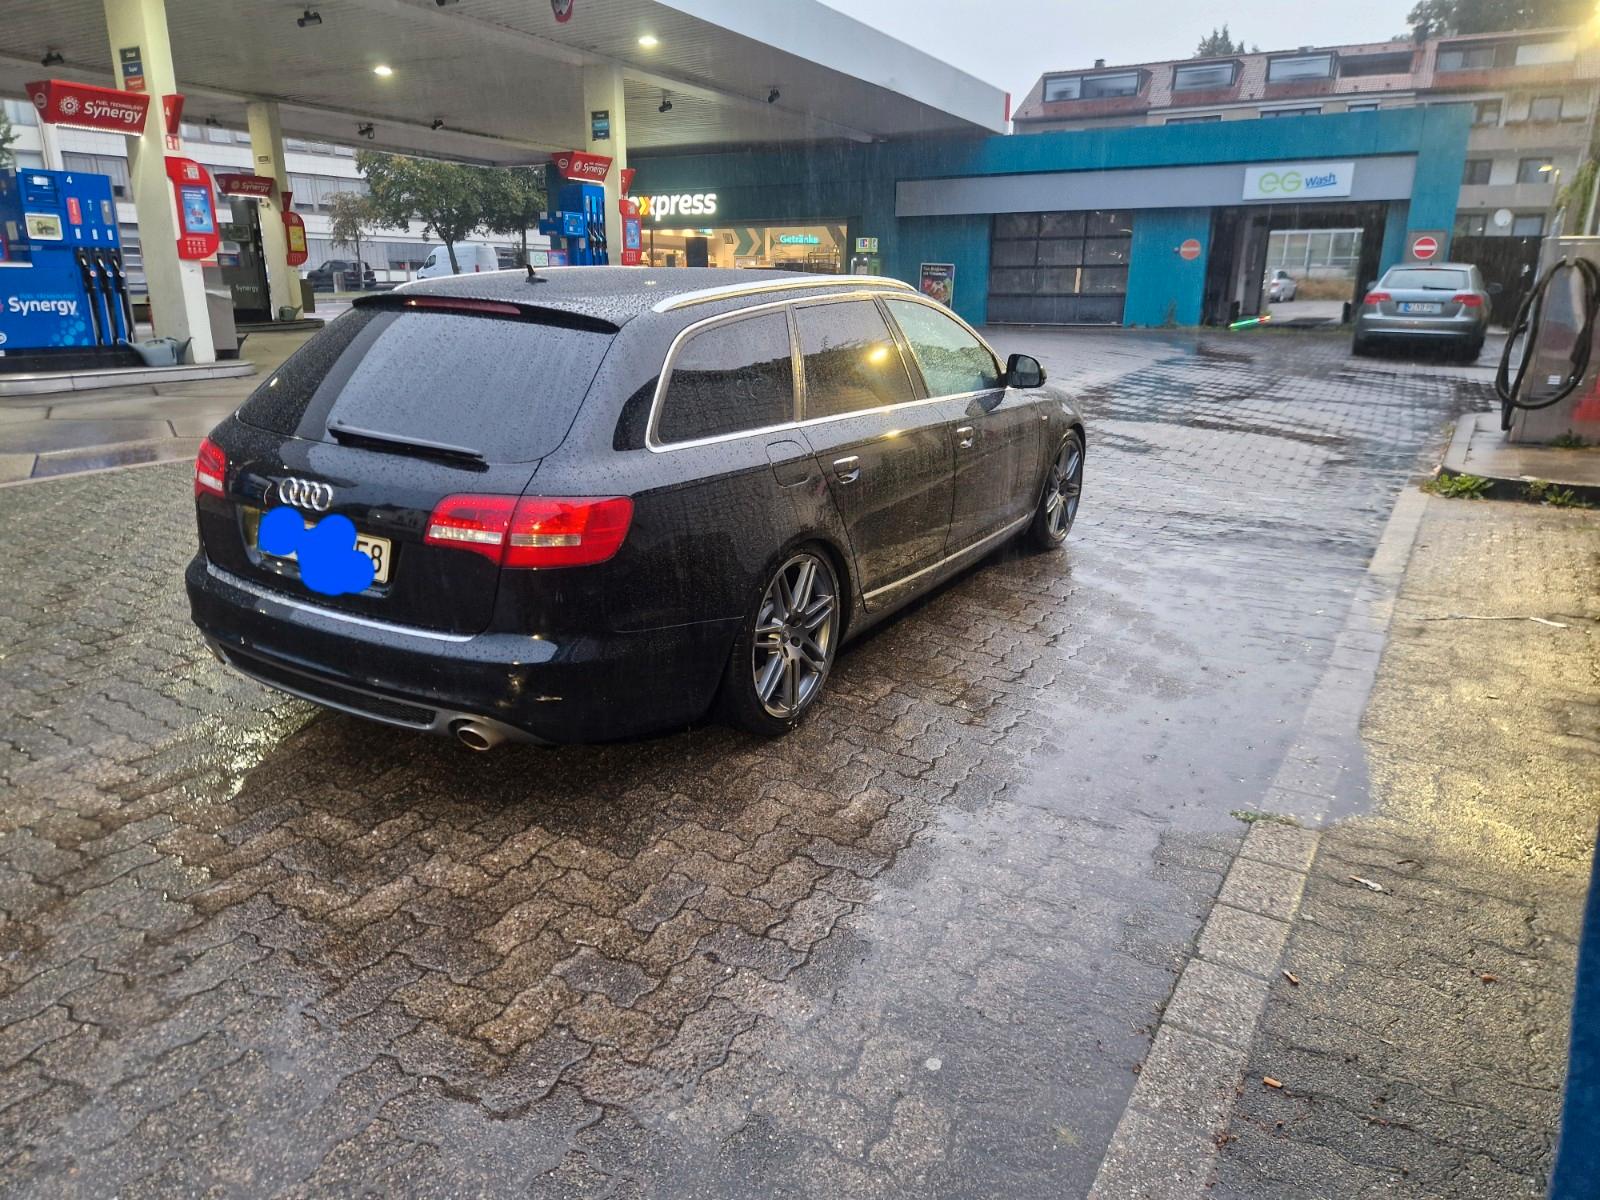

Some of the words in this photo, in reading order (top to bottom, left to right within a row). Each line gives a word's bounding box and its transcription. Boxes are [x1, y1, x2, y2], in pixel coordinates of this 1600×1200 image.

[84, 102, 142, 123] Synergy
[582, 162, 607, 175] Synergy
[66, 175, 73, 184] 4
[1305, 172, 1336, 189] Wash
[241, 181, 270, 193] Synergy
[235, 284, 259, 293] Synergy
[8, 296, 77, 316] Synergy
